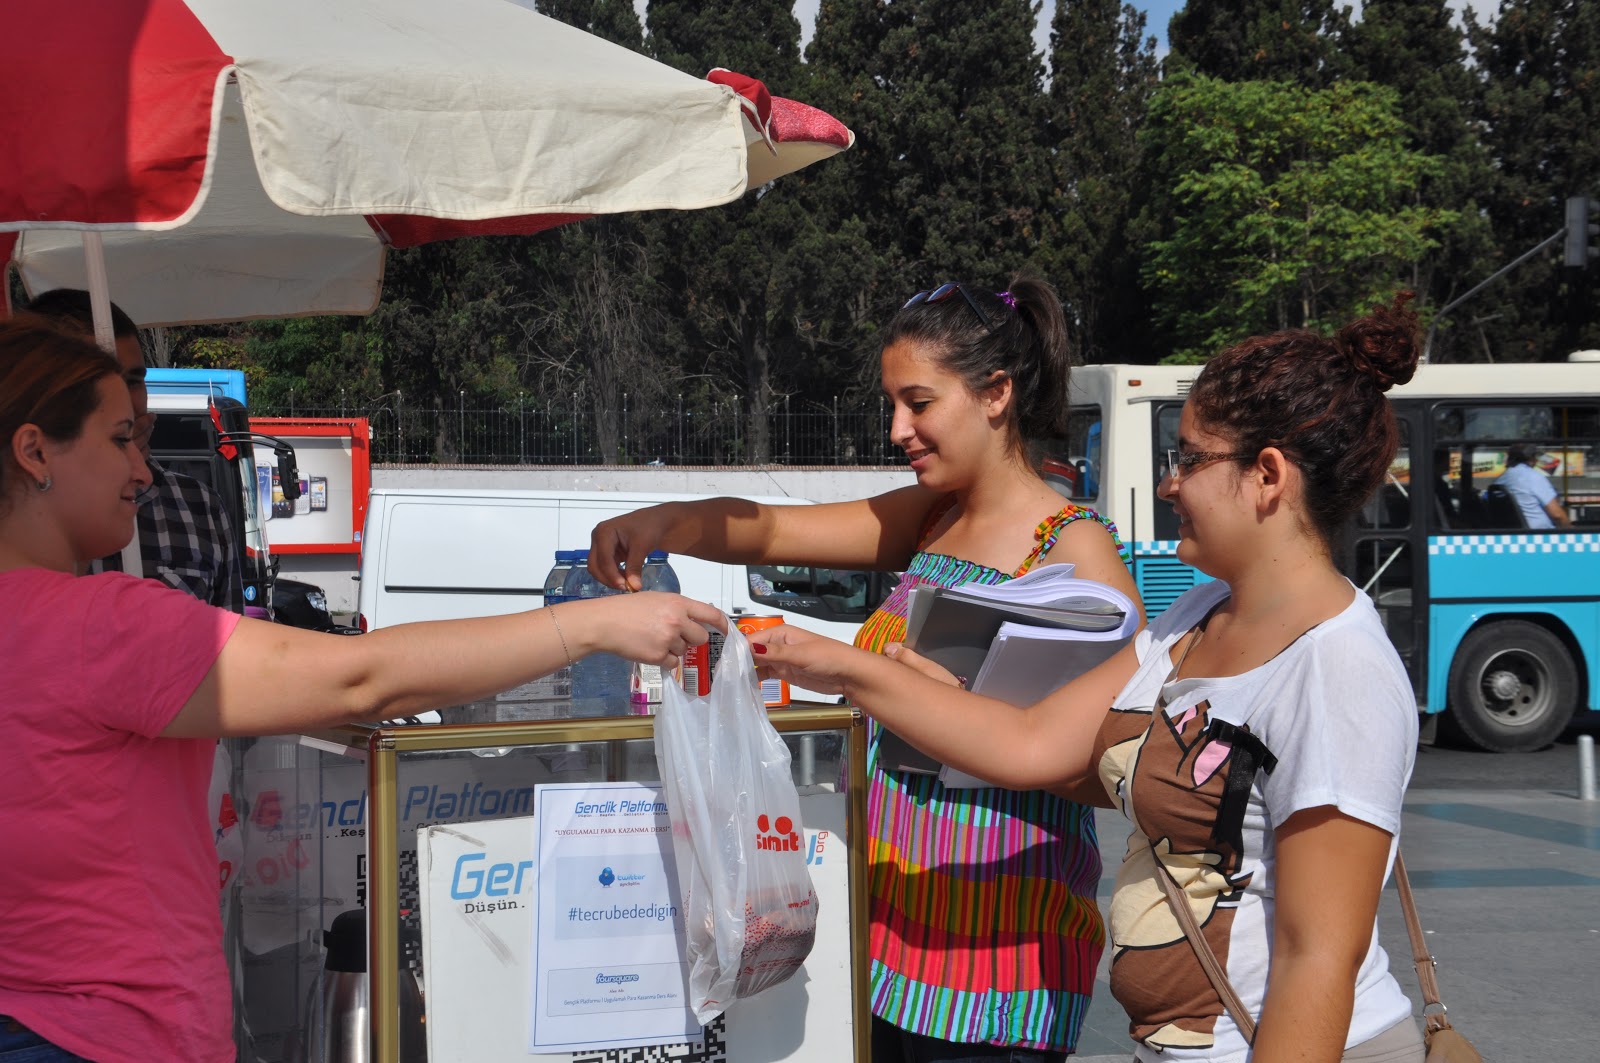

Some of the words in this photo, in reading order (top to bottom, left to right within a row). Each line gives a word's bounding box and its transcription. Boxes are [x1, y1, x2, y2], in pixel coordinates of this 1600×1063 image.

[403, 782, 534, 821] Platform
[568, 903, 677, 921] #tecrubededigin
[596, 973, 639, 984] foursquare
